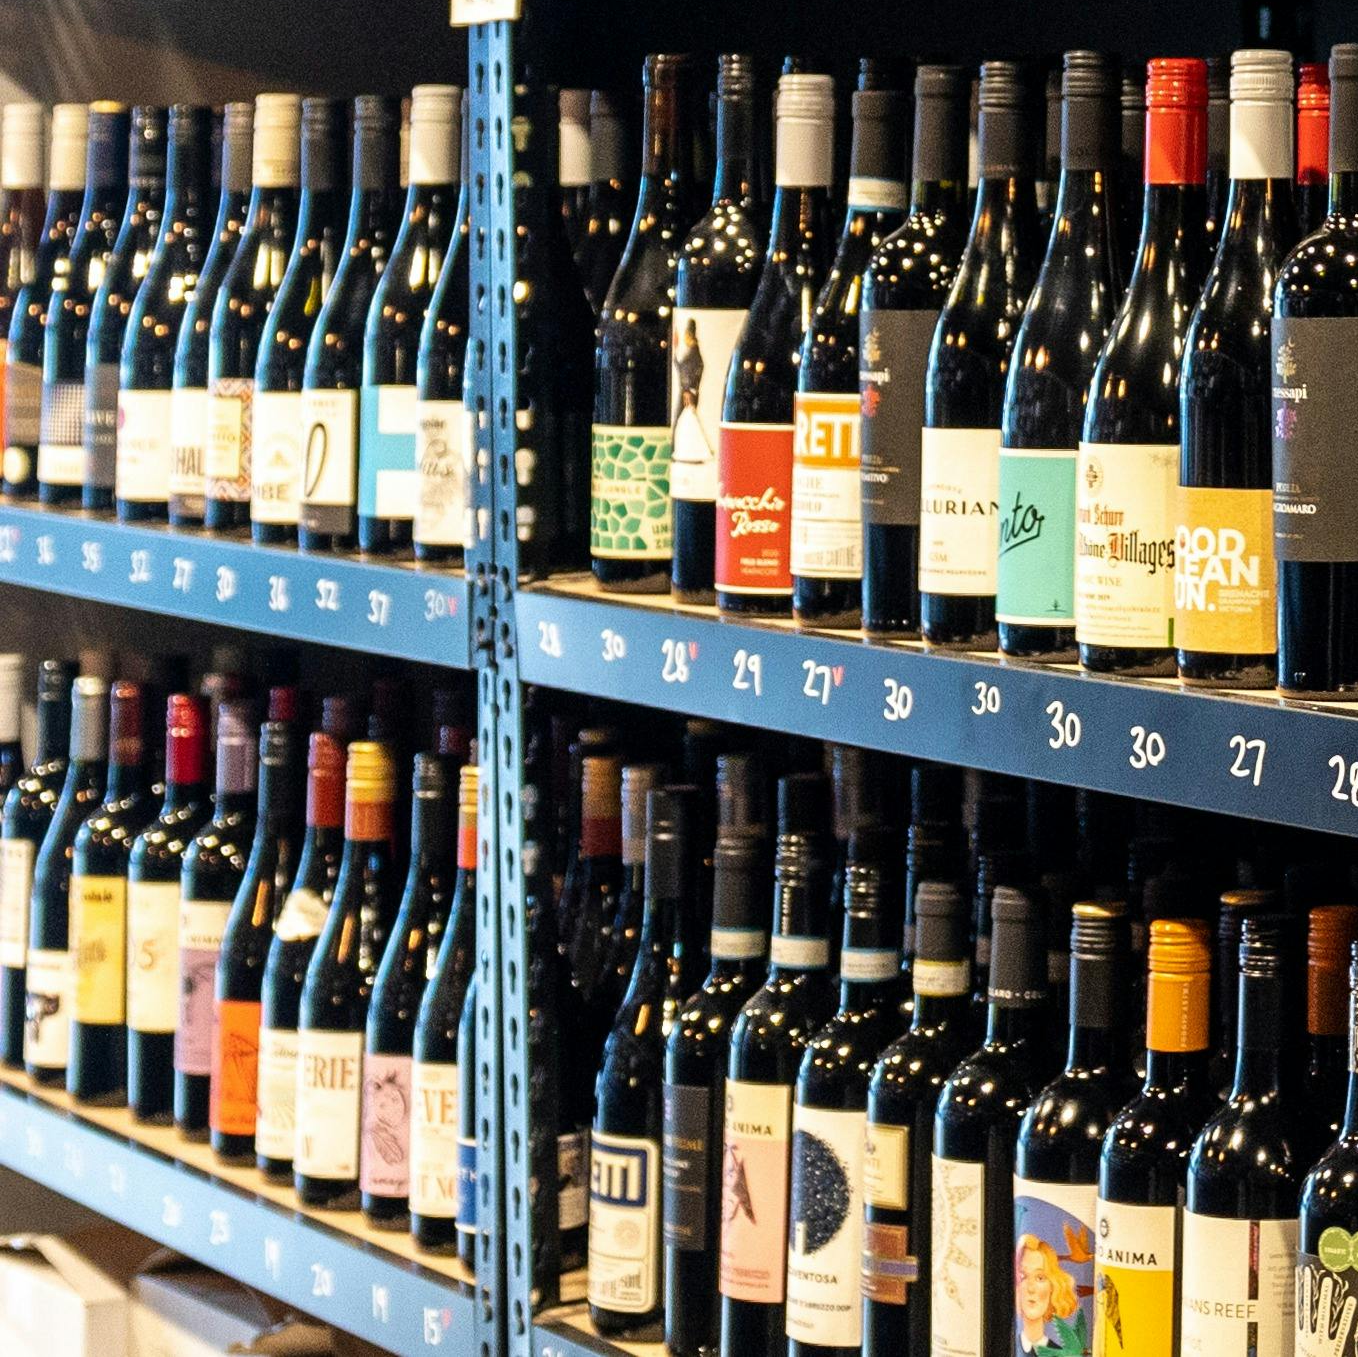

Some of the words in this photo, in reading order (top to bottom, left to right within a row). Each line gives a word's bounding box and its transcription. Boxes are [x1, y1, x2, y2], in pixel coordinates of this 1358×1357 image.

[730, 511, 781, 538] Rosso
[423, 589, 446, 622] 30
[600, 629, 626, 661] 30
[661, 639, 690, 683] 28
[732, 649, 763, 696] 29
[802, 660, 832, 706] 27
[883, 679, 914, 721] 30
[971, 681, 1000, 715] 30
[1046, 700, 1082, 750] 30
[1129, 725, 1166, 769] 30
[1229, 734, 1266, 786] 27
[1107, 1249, 1158, 1267] ANIMA
[1214, 1301, 1257, 1319] REEF
